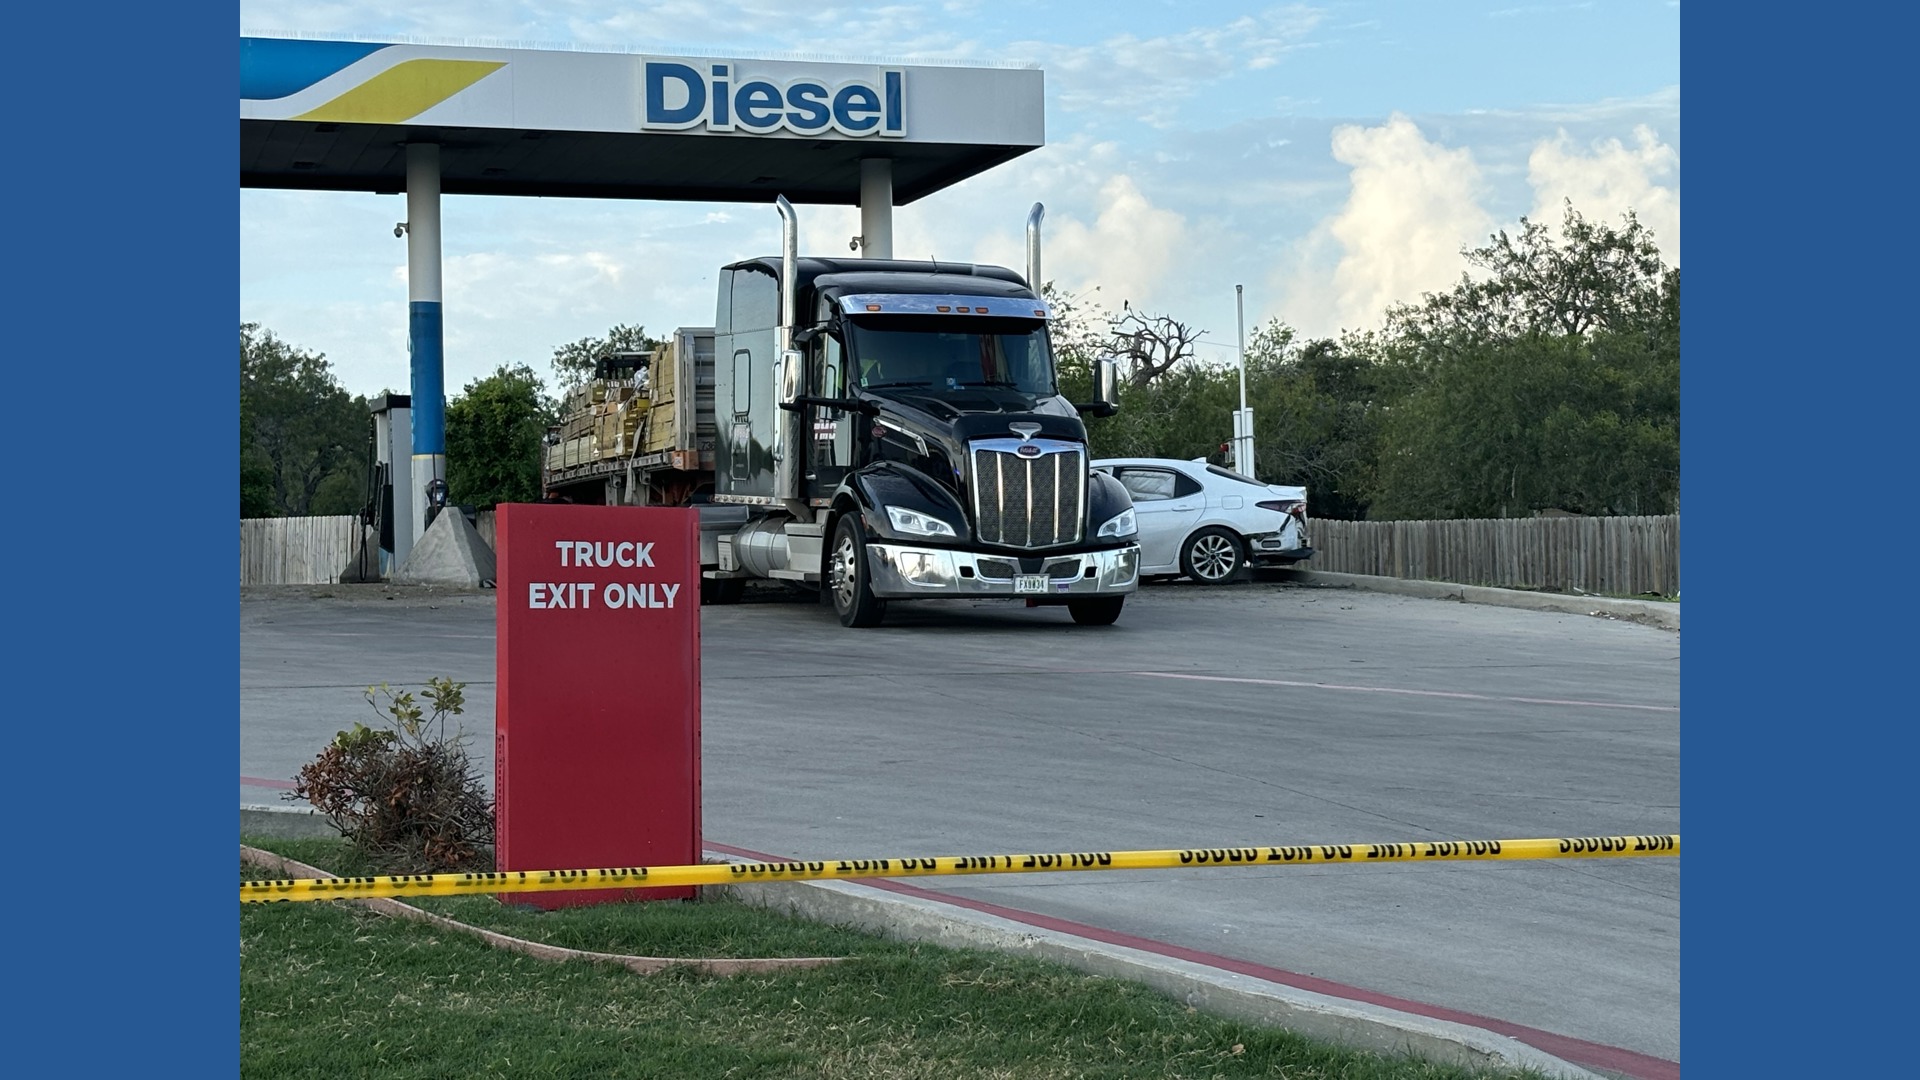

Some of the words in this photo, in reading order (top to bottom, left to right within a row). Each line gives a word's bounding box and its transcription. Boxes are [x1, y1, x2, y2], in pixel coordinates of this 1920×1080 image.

[645, 62, 902, 131] Diesel
[556, 541, 655, 567] TRUCK
[529, 583, 595, 609] EXIT
[604, 583, 680, 609] ONLY
